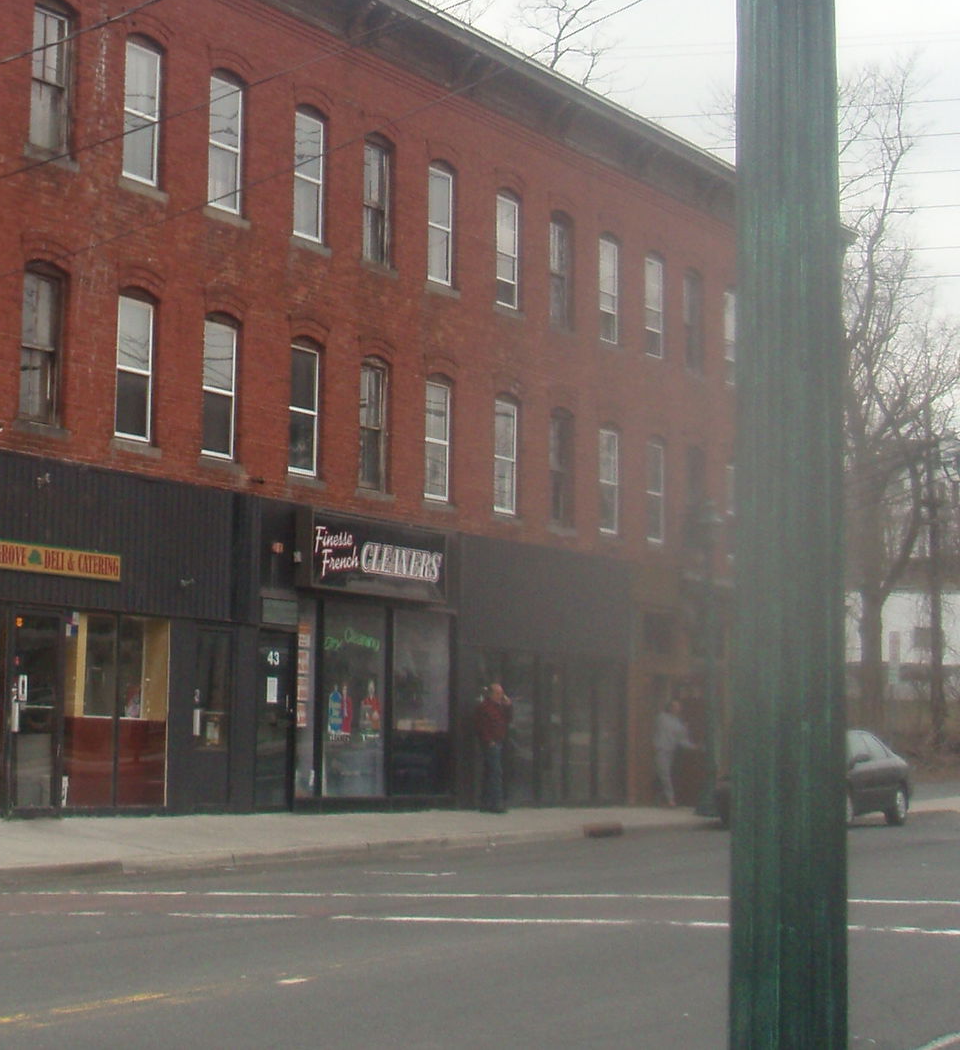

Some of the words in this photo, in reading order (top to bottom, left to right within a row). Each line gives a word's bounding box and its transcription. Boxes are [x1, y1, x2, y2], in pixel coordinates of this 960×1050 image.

[315, 526, 353, 553] Finesse
[44, 550, 64, 570] DELI
[67, 553, 74, 571] &
[78, 554, 119, 577] CATERING
[321, 546, 359, 578] French
[361, 542, 442, 582] CLEANERS
[267, 651, 280, 666] 43
